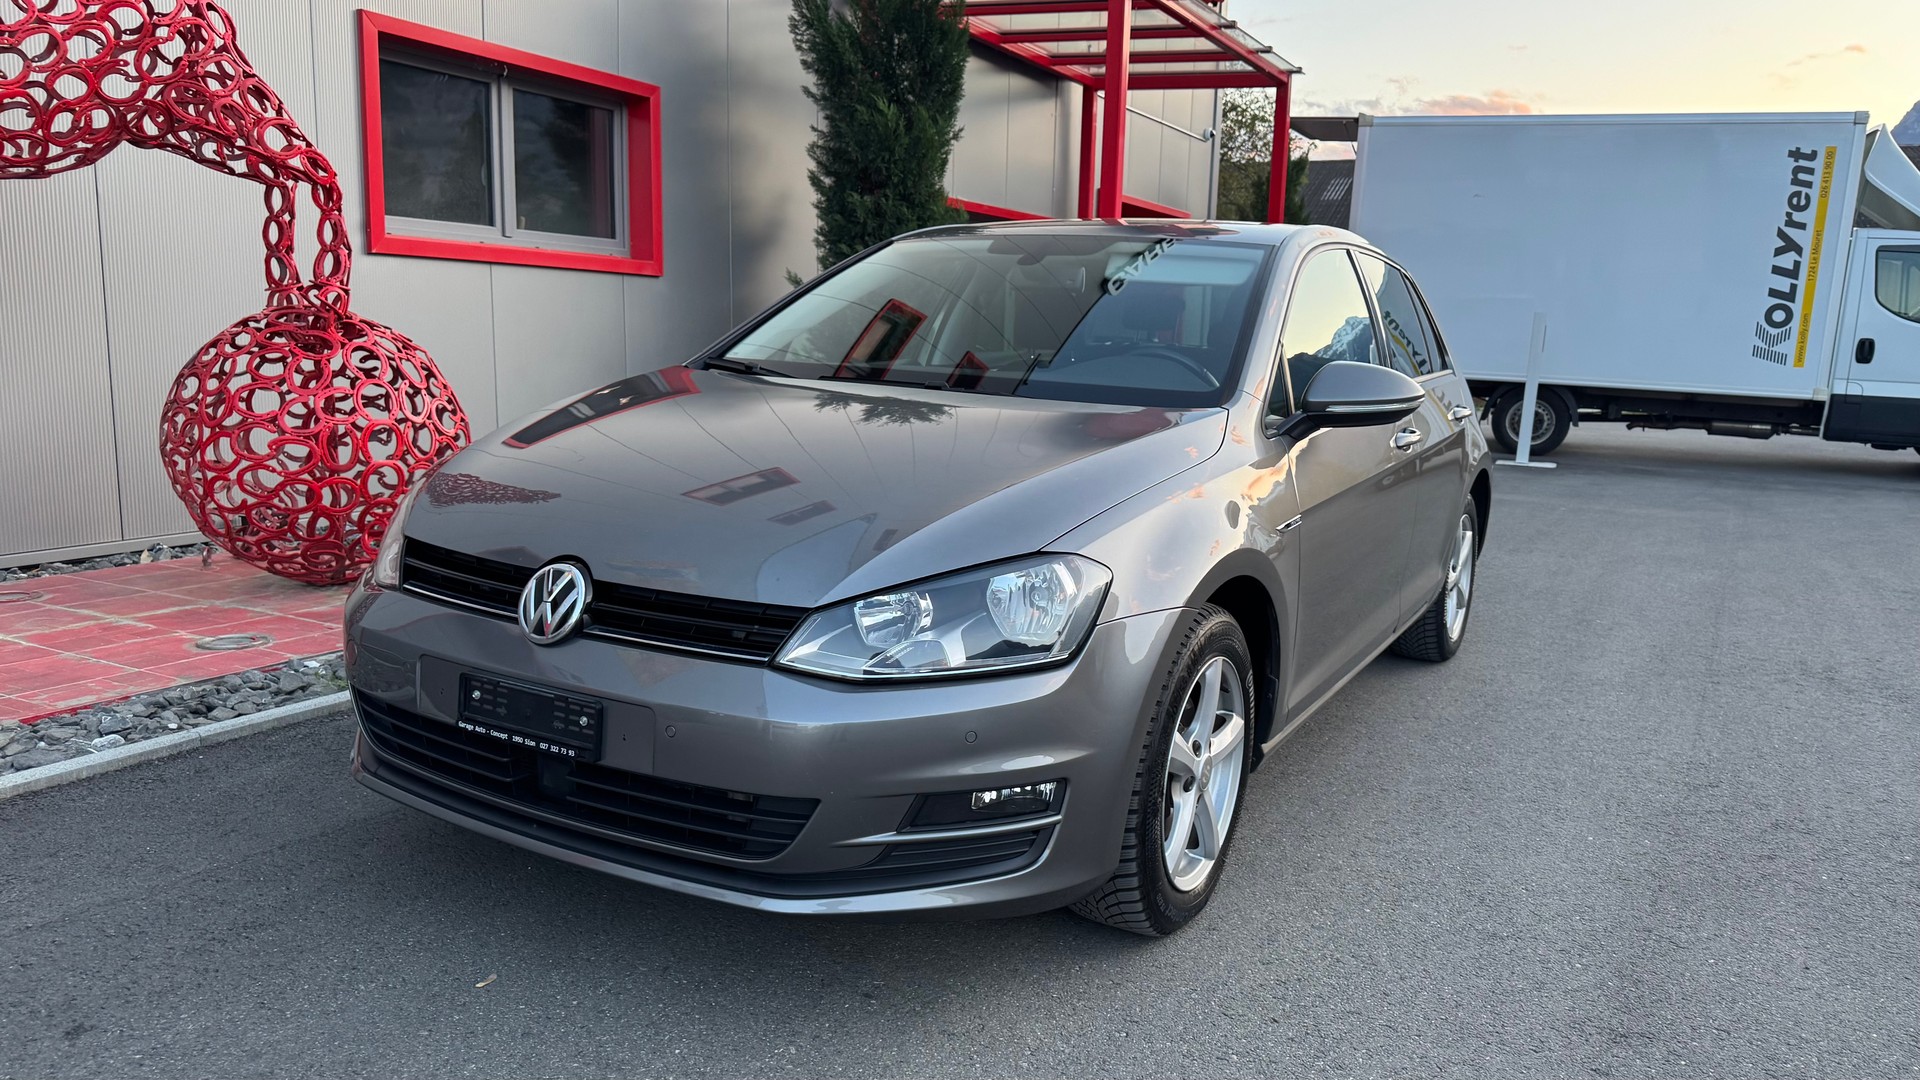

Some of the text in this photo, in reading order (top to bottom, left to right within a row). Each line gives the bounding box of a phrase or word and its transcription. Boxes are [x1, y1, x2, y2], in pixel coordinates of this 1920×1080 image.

[1797, 150, 1834, 363] www.kolly.com 1724 Le Mouret 026 413 90 00
[522, 565, 583, 642] VW
[458, 720, 474, 731] Garage
[475, 725, 486, 734] Auto
[490, 729, 508, 740] Concept
[512, 735, 524, 744] 1950
[524, 738, 536, 747] Sion
[539, 742, 549, 750] 027
[560, 747, 567, 755] 73
[568, 749, 575, 757] 93
